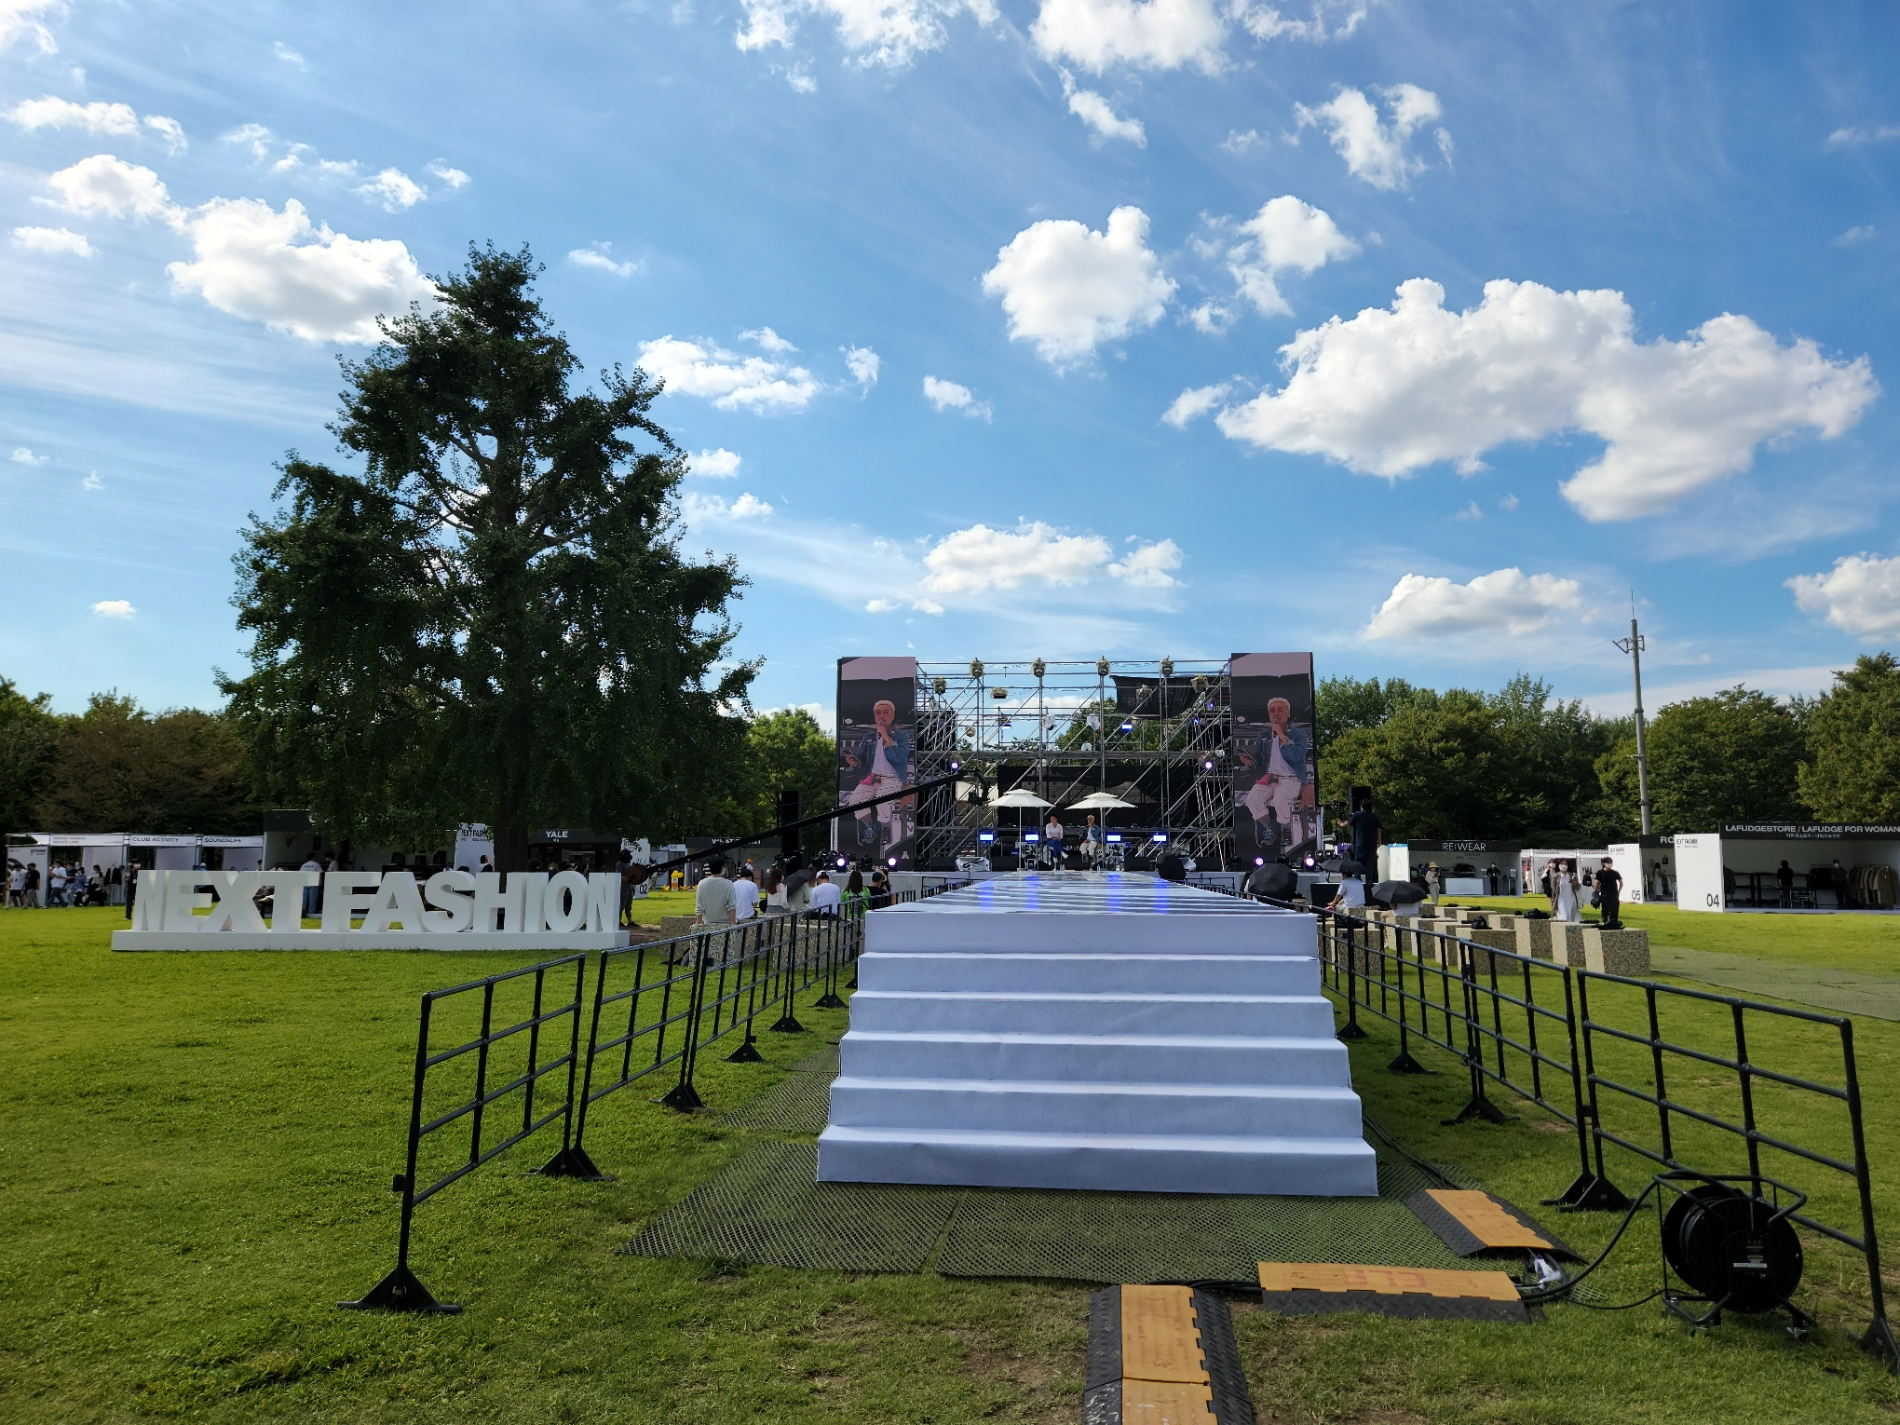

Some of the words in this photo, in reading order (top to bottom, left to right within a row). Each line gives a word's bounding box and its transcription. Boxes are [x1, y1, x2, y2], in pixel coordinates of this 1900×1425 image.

[1725, 825, 1797, 833] LAFUDGESTORE
[1802, 825, 1843, 833] LAFUDGE
[1844, 825, 1864, 833] FOR
[133, 870, 320, 931] NEXT
[322, 871, 621, 932] FASHION
[1631, 889, 1641, 901] 05
[1706, 893, 1720, 908] 04
